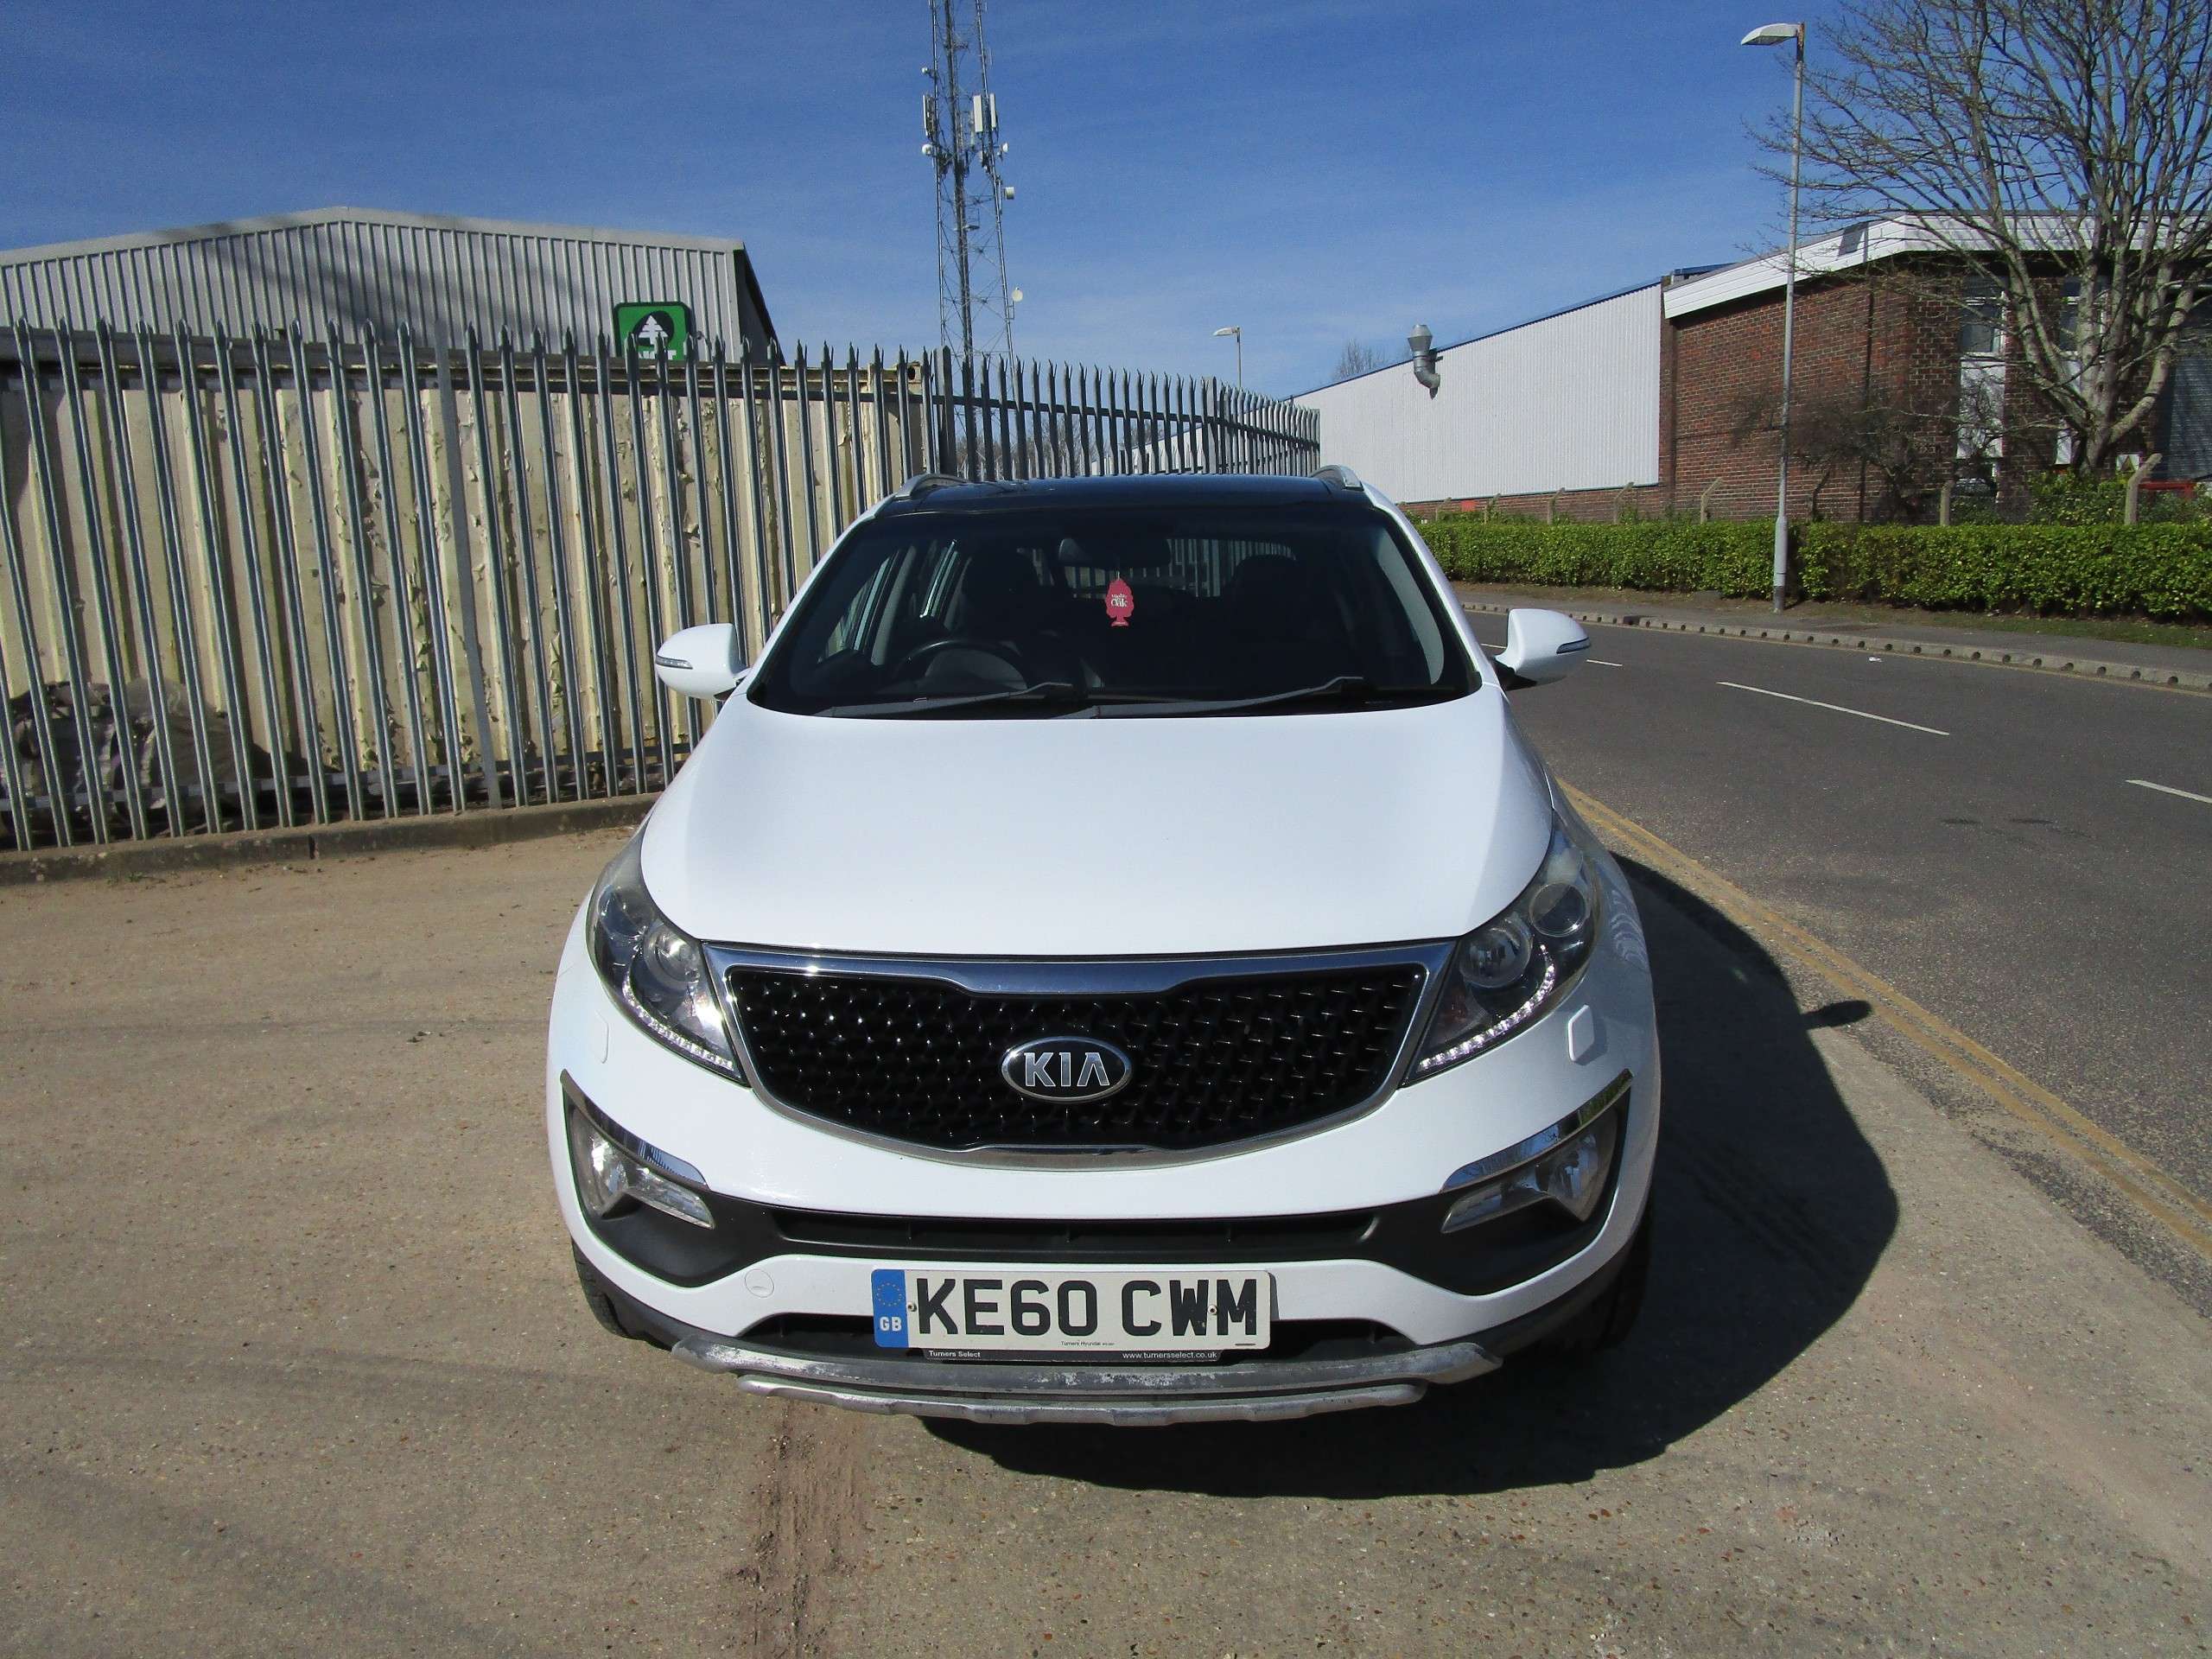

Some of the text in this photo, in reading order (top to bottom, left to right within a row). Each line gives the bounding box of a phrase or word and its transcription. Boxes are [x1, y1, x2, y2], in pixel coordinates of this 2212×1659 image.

[1023, 1052, 1110, 1087] KIA
[880, 1316, 902, 1332] GB
[916, 1278, 1257, 1337] KE60 CWM
